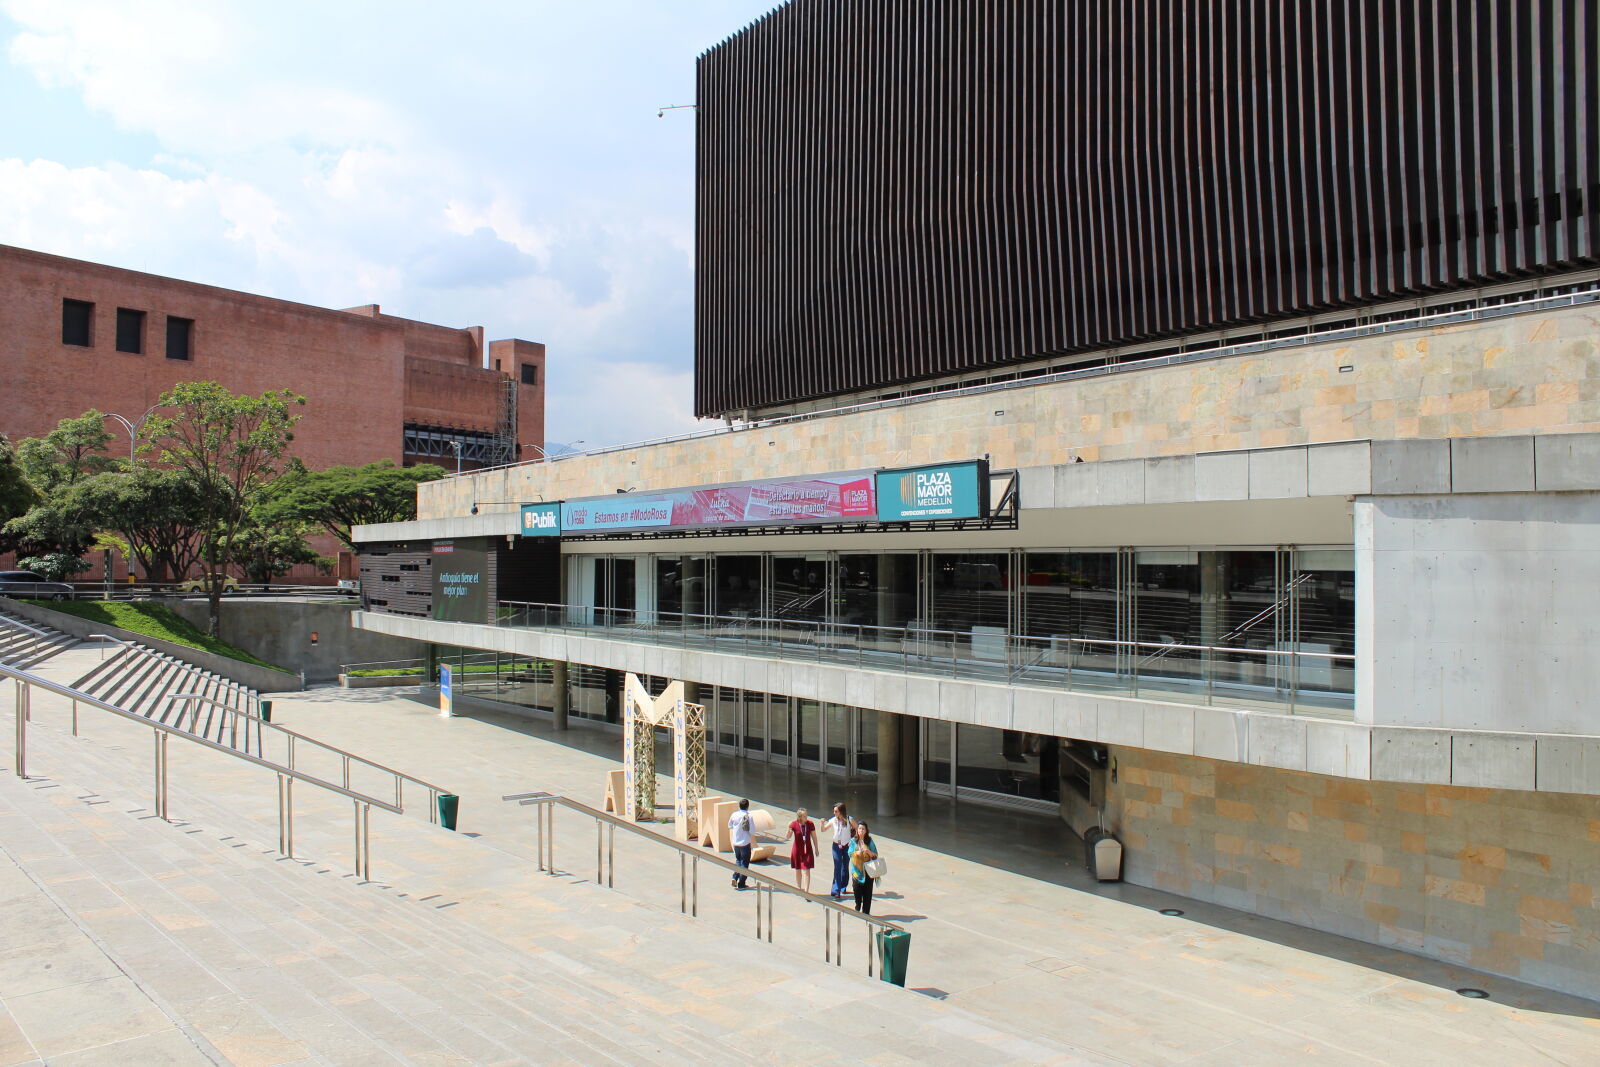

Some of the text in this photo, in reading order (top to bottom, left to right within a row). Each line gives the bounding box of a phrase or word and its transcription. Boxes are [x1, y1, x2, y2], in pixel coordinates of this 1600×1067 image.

[917, 472, 951, 486] PLAZA
[851, 489, 867, 497] PLAZA
[851, 494, 868, 502] MAYOR
[917, 484, 952, 498] MAYOR
[532, 511, 557, 529] Publik
[594, 507, 668, 524] Estamos en #ModoRosa
